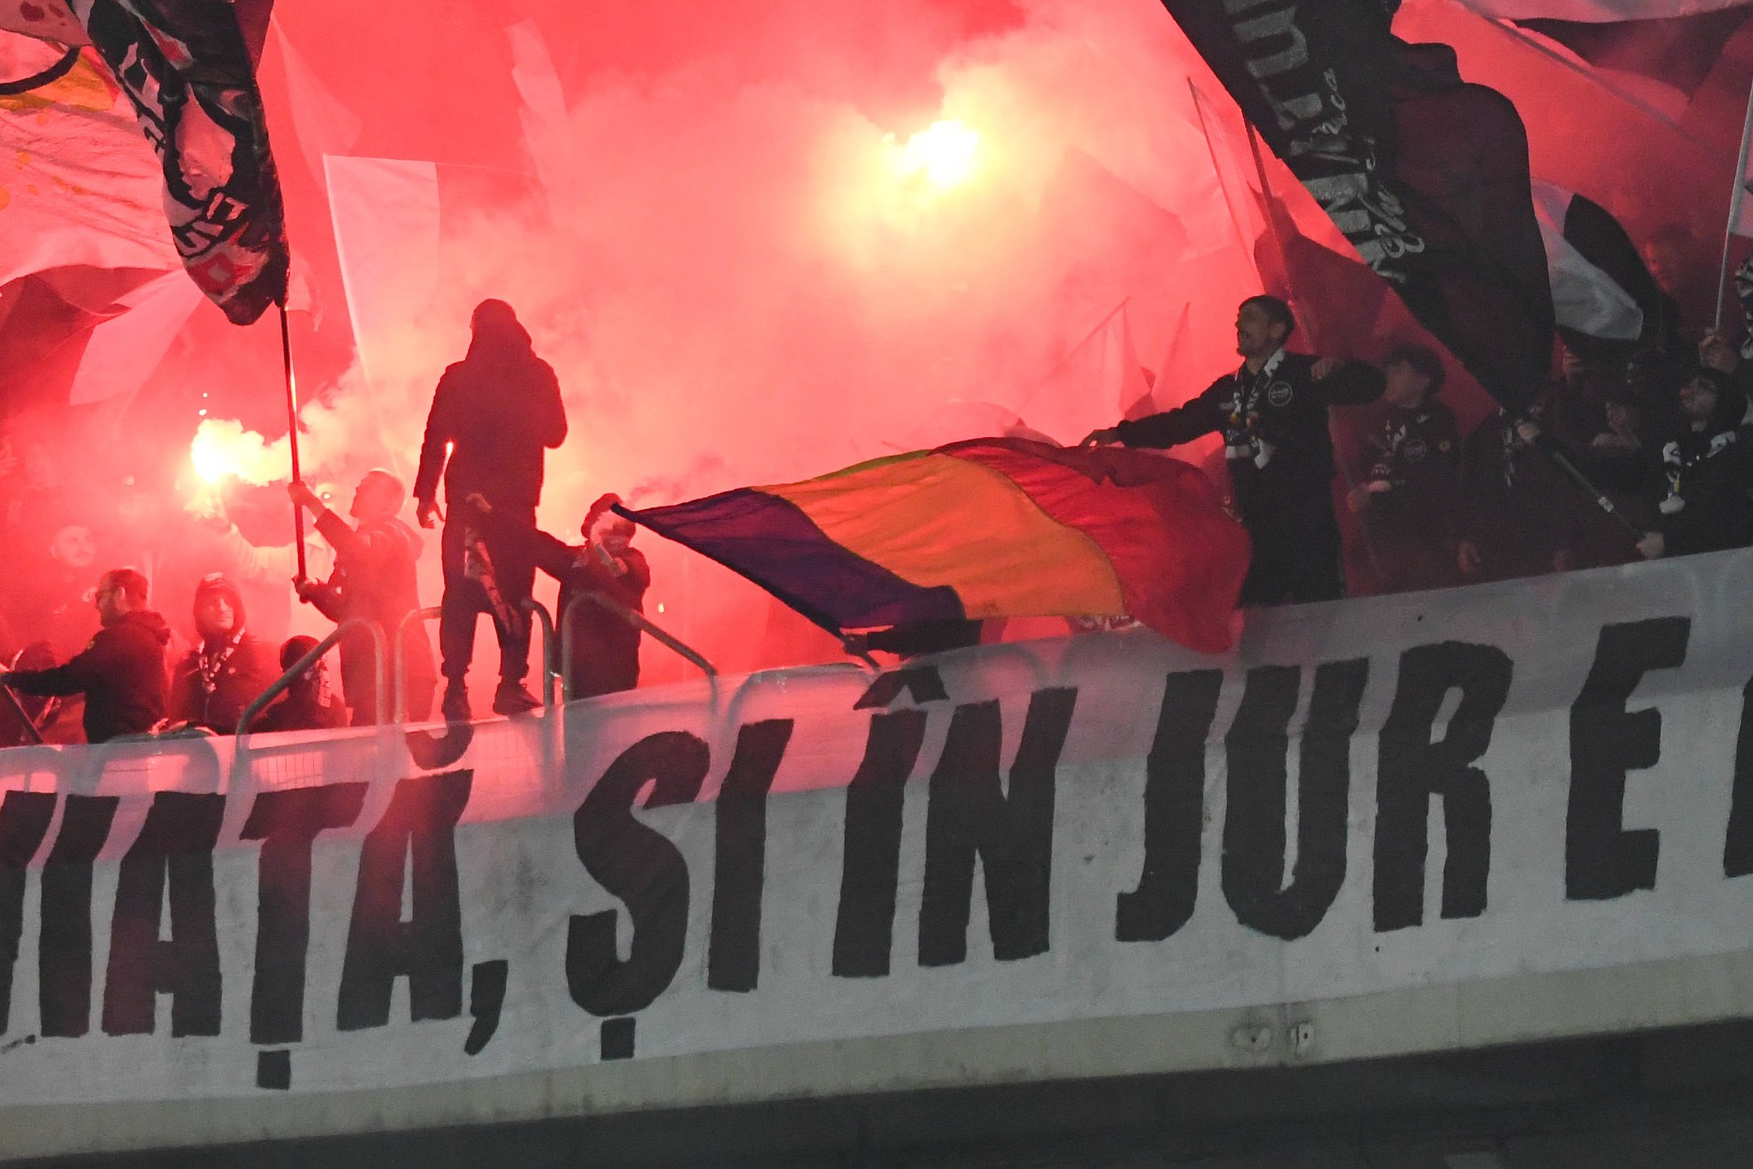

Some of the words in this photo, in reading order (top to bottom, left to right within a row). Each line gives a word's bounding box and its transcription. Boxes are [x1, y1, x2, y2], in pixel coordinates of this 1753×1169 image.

[565, 719, 794, 1060] ȘI
[832, 665, 1077, 978] ÎN
[1115, 640, 1514, 943] JUR
[1565, 617, 1692, 900] E
